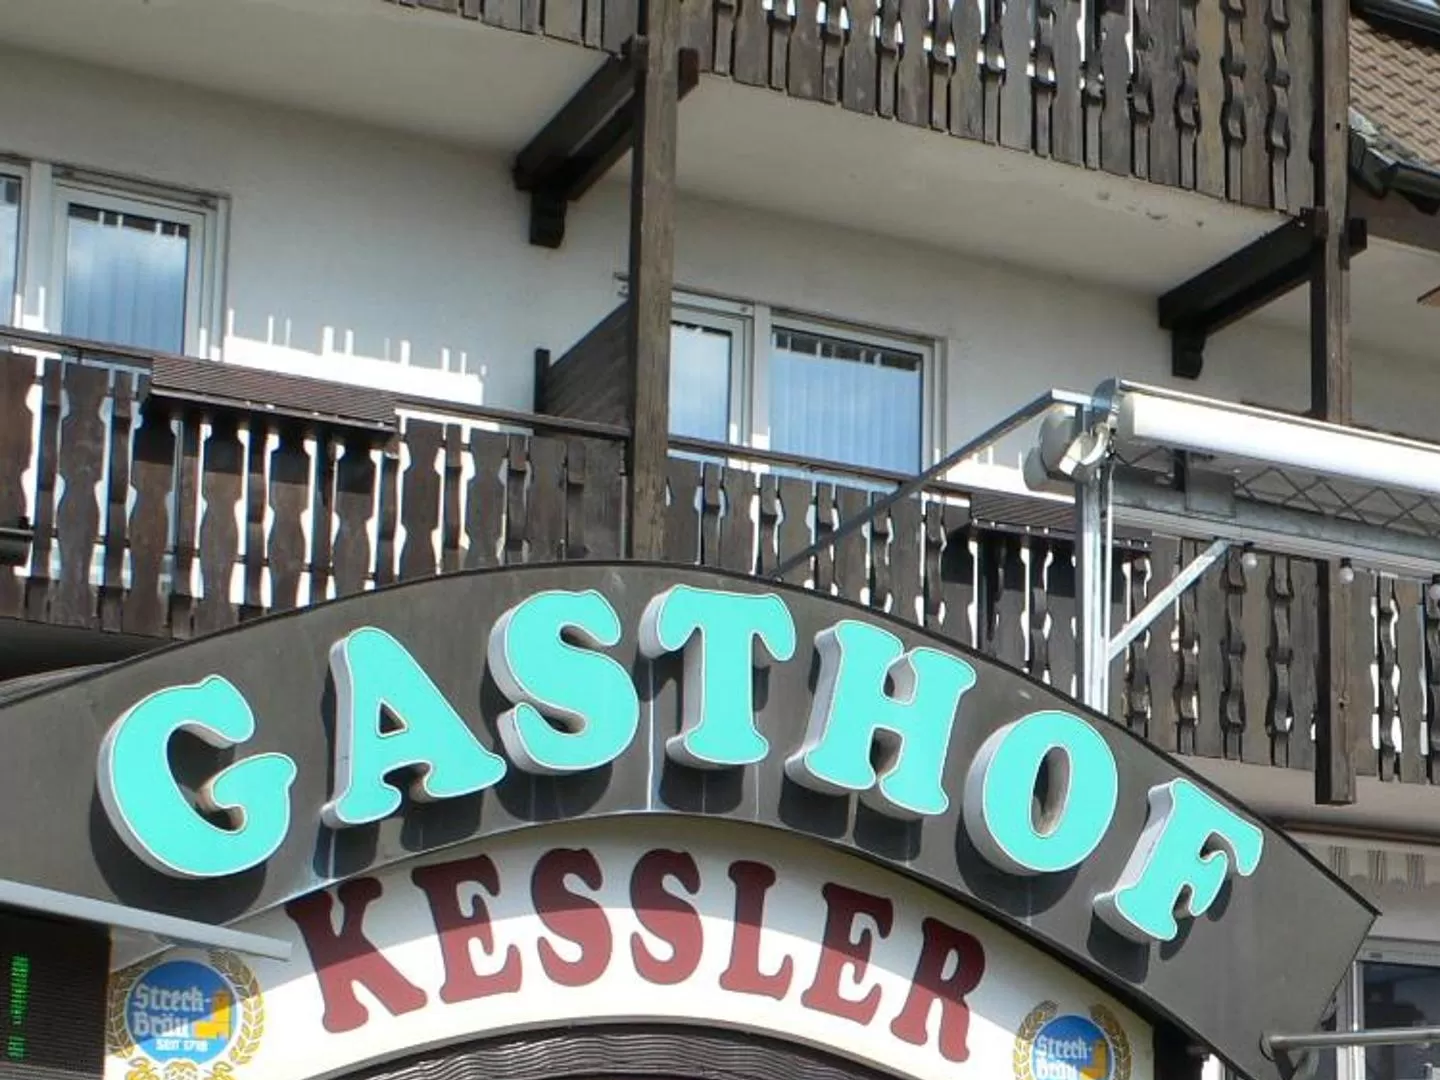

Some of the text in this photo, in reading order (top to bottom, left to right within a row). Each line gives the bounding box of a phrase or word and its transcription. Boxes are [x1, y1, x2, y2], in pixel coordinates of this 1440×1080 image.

[98, 584, 1264, 942] GASTHOF
[134, 1011, 189, 1038] Bräu
[285, 847, 987, 1062] KESSLER
